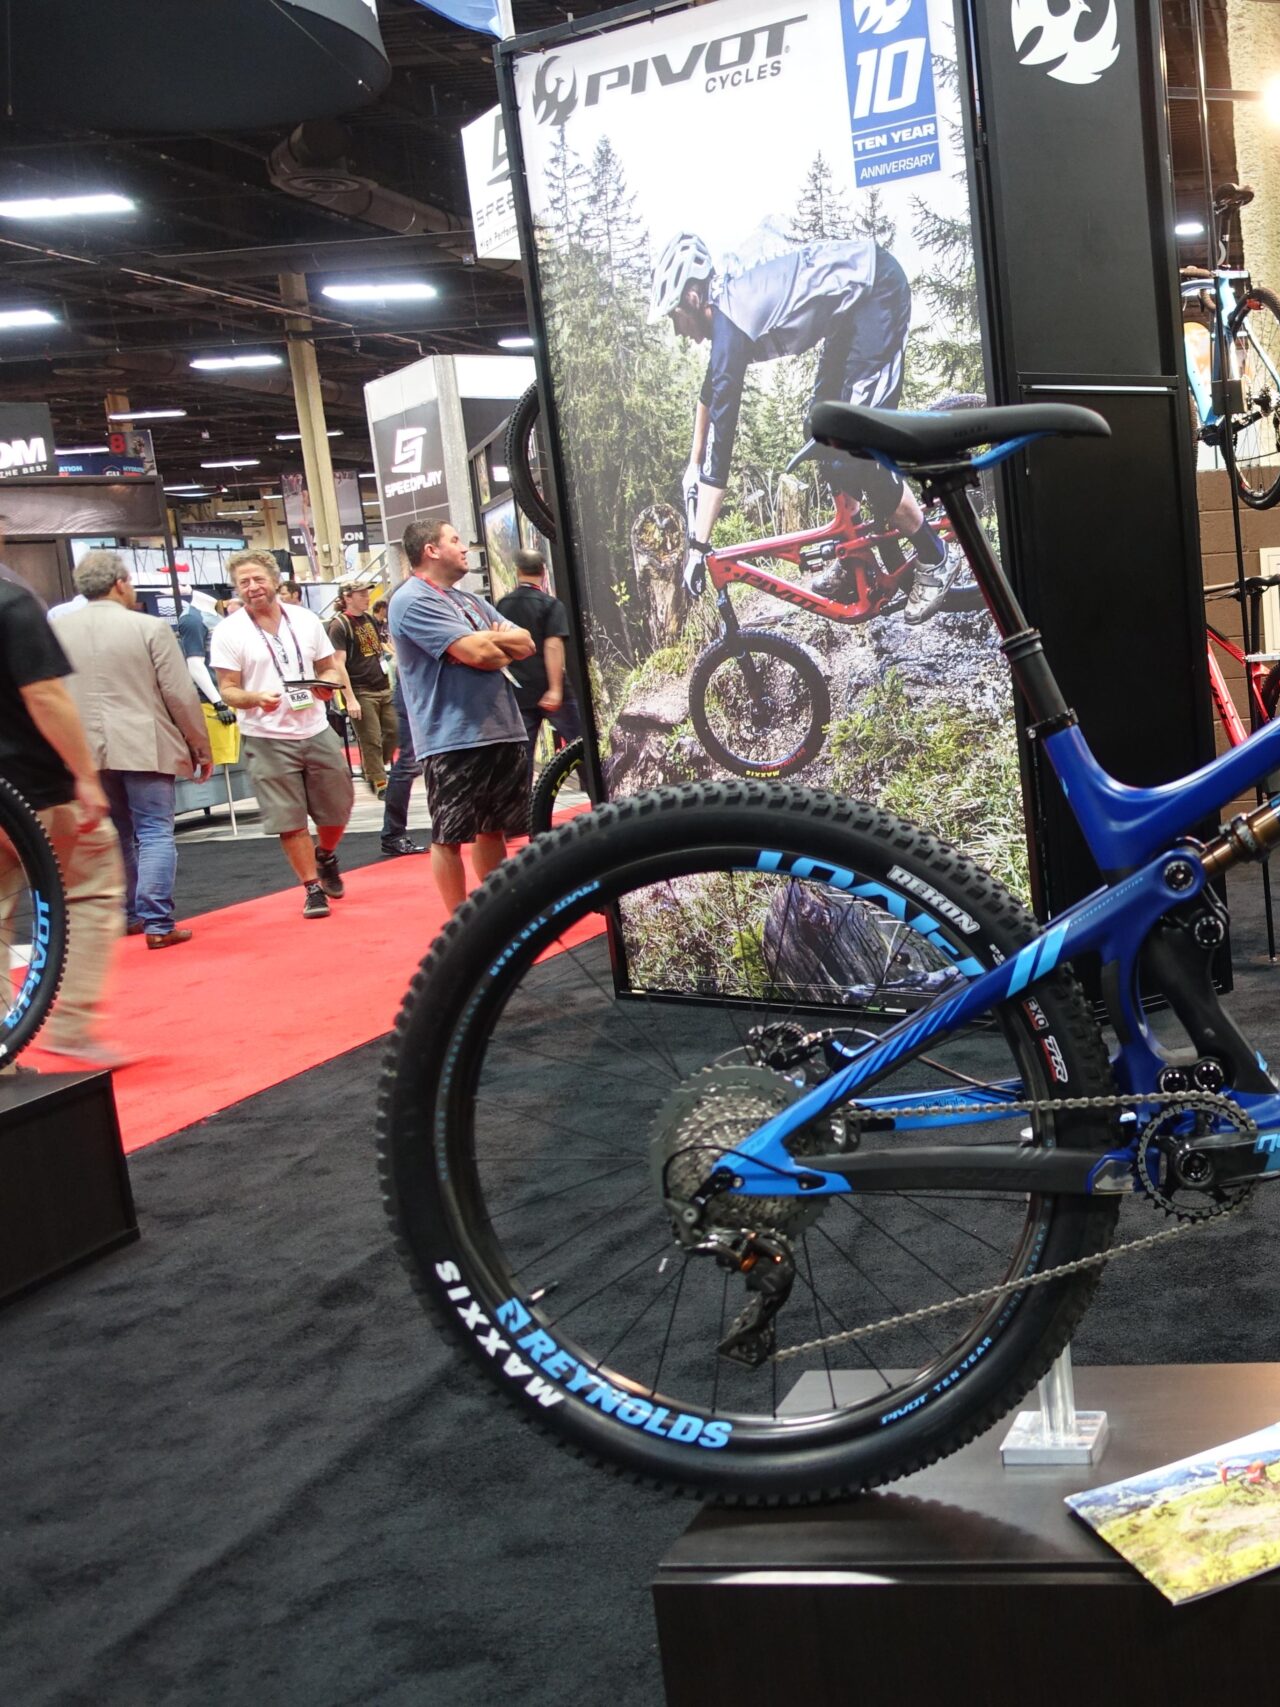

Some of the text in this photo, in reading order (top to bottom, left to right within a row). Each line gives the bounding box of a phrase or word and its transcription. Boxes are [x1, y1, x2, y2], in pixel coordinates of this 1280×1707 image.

[584, 15, 808, 107] PIVOT
[705, 60, 782, 94] CYCLES
[853, 37, 926, 119] 10
[853, 122, 936, 153] TEN YEAR
[859, 151, 936, 181] ANNIVERSARY
[22, 464, 48, 475] BEST
[384, 470, 443, 498] SPEEDPLAY
[732, 850, 986, 977] PIVOT
[887, 864, 981, 935] REKON
[435, 1259, 565, 1408] MAXXIS
[516, 1328, 733, 1449] REYNOLDS
[880, 1392, 928, 1426] PIVOT
[933, 1370, 960, 1393] TEN
[961, 1335, 993, 1370] YEAR
